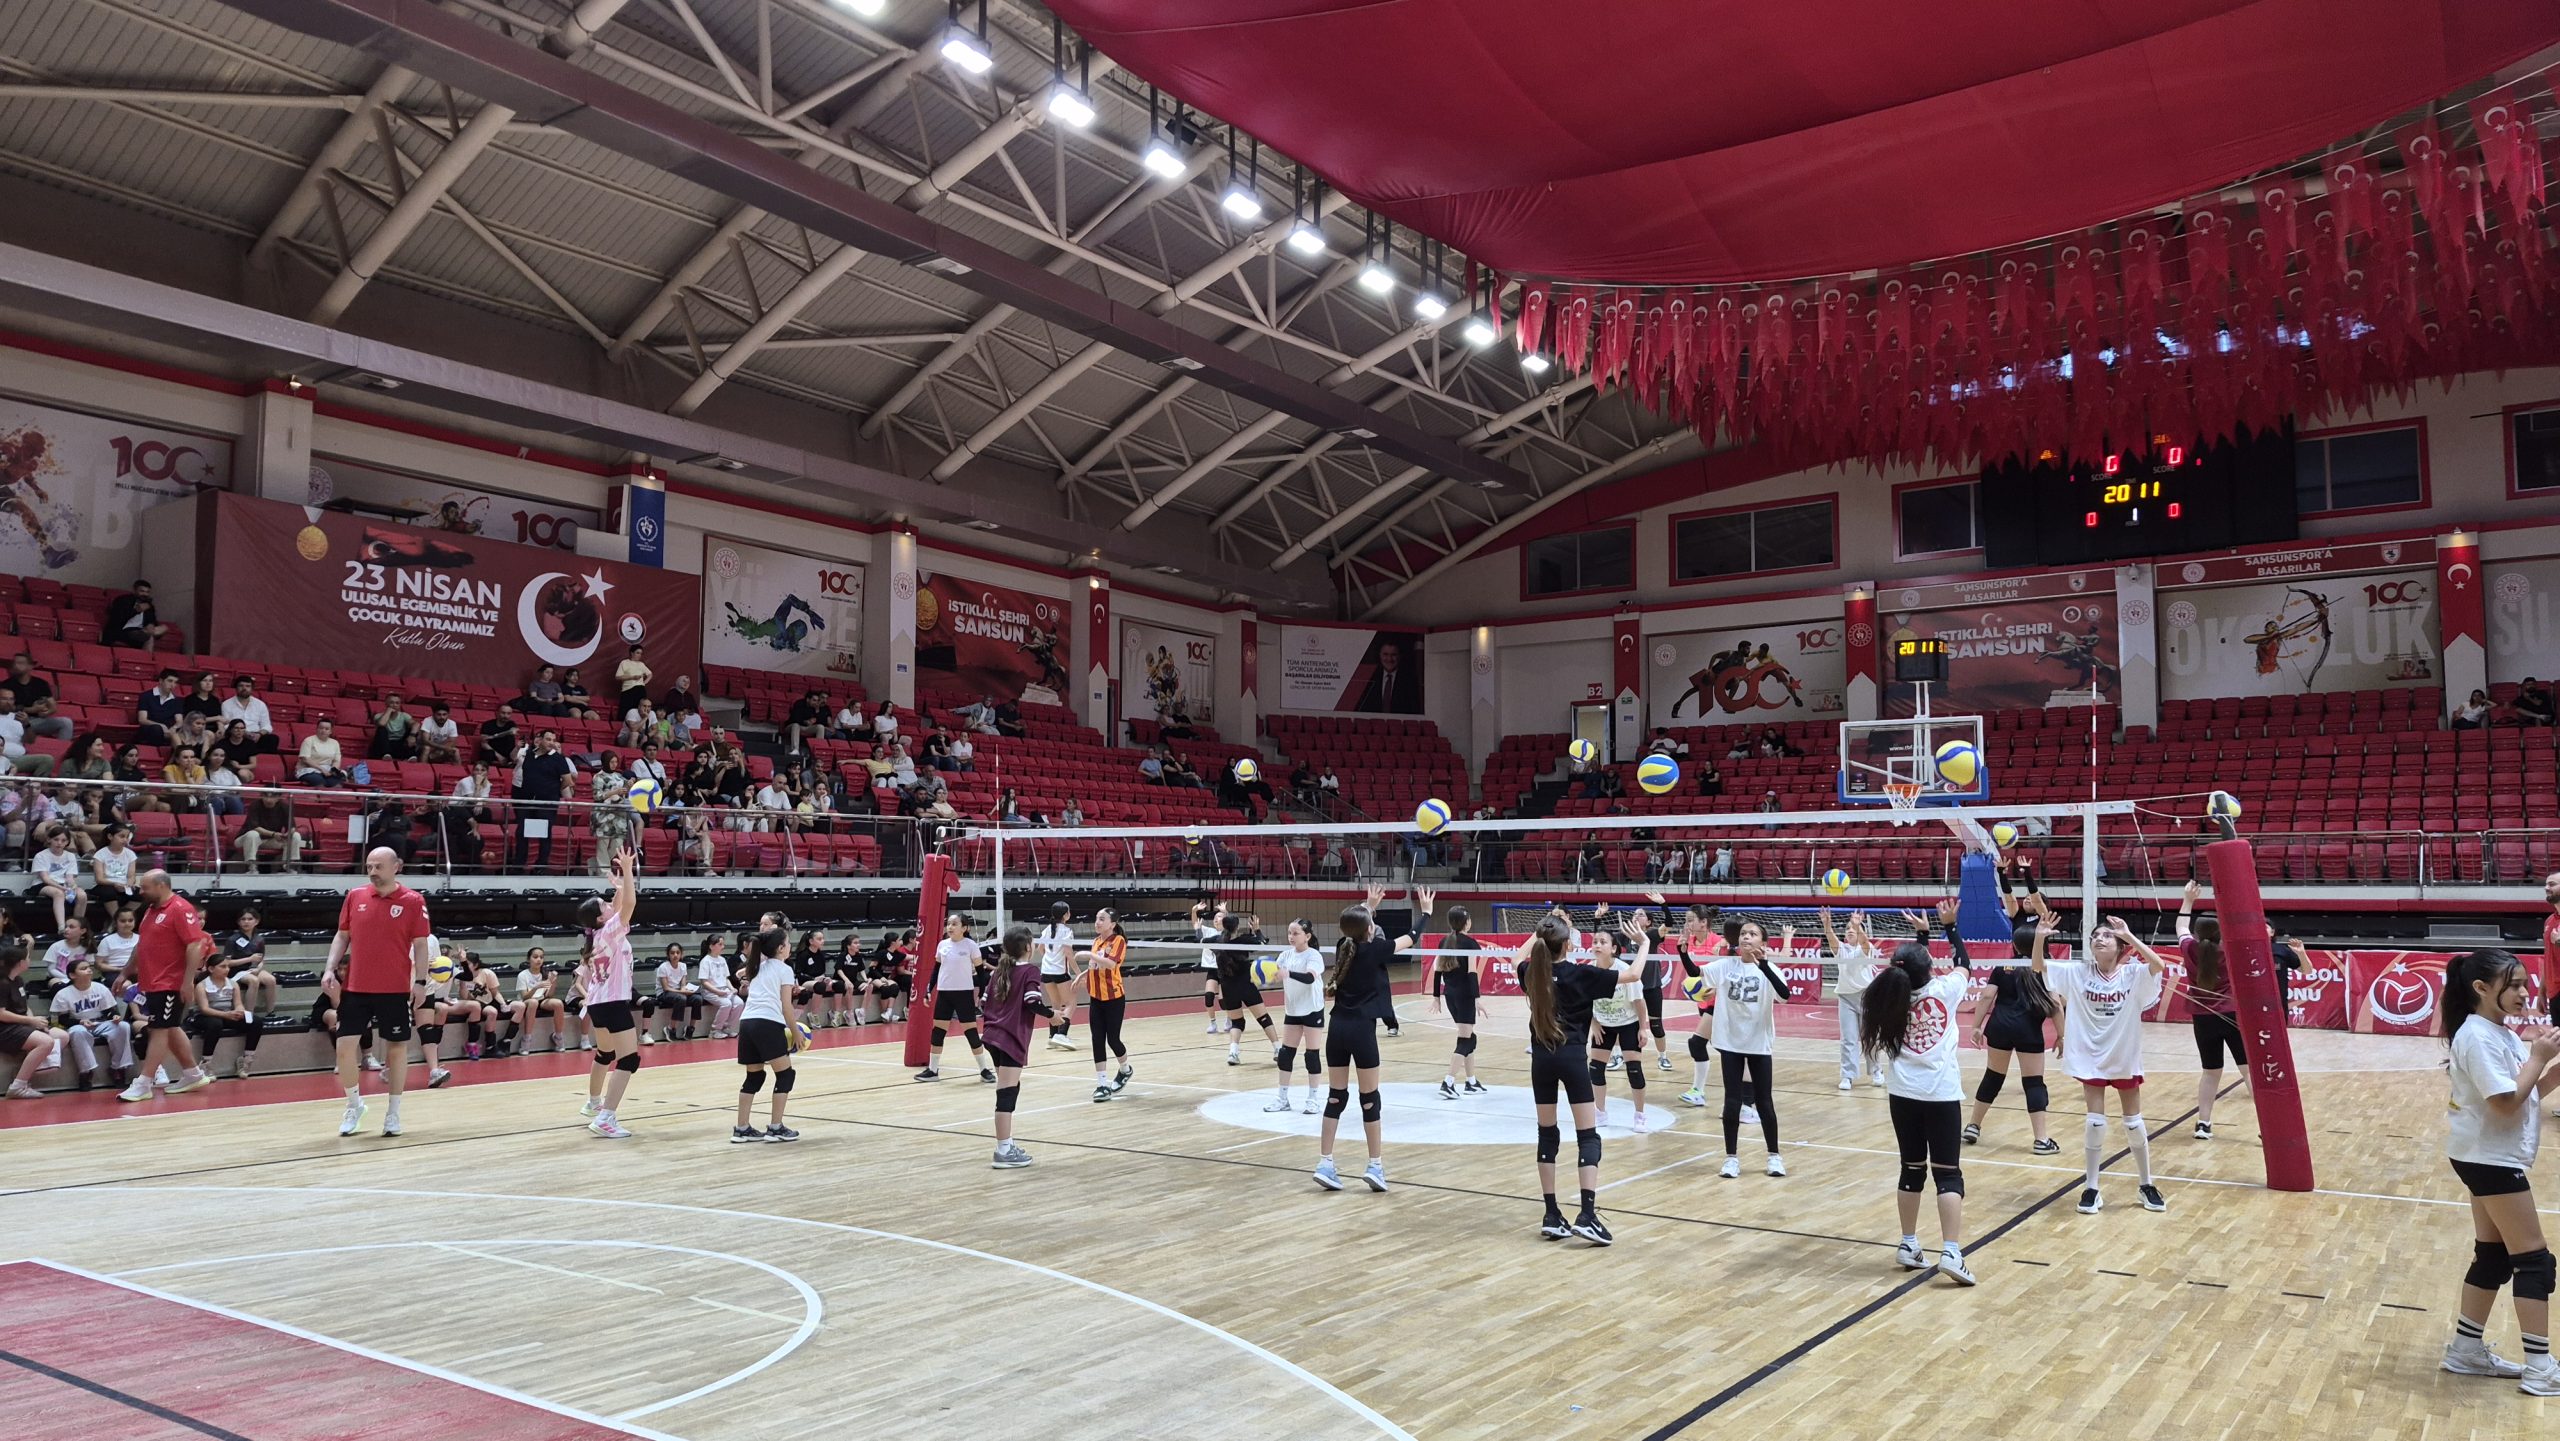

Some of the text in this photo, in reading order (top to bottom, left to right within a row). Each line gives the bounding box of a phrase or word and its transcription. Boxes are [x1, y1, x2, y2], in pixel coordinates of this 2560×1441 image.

[2169, 447, 2182, 465] 0
[2153, 463, 2175, 474] SCORE
[2132, 507, 2138, 521] 1
[2168, 502, 2179, 518] 0
[2086, 511, 2097, 527] 0
[2244, 549, 2333, 567] SAMSUNSPOR'A
[2257, 562, 2321, 577] BAŞARILAR
[343, 560, 502, 609] 23 NİSAN
[1953, 577, 2029, 593] SAMSUNSPOR'A
[1964, 589, 2019, 603] BAŞARILAR
[341, 589, 499, 622] ULUSAL EGEMENLİK VE
[948, 600, 1030, 626] İSTİKLAL ŞEHRİ
[348, 607, 496, 637] ÇOCUK BAYRAMIMIZ
[954, 615, 1025, 643] SAMSUN
[2006, 622, 2053, 639] ŞEHRİ
[383, 627, 466, 651] Kutlu Olsun
[1899, 641, 1915, 655] 20
[1947, 636, 2046, 660] SAMSUN
[1588, 686, 1602, 696] B2
